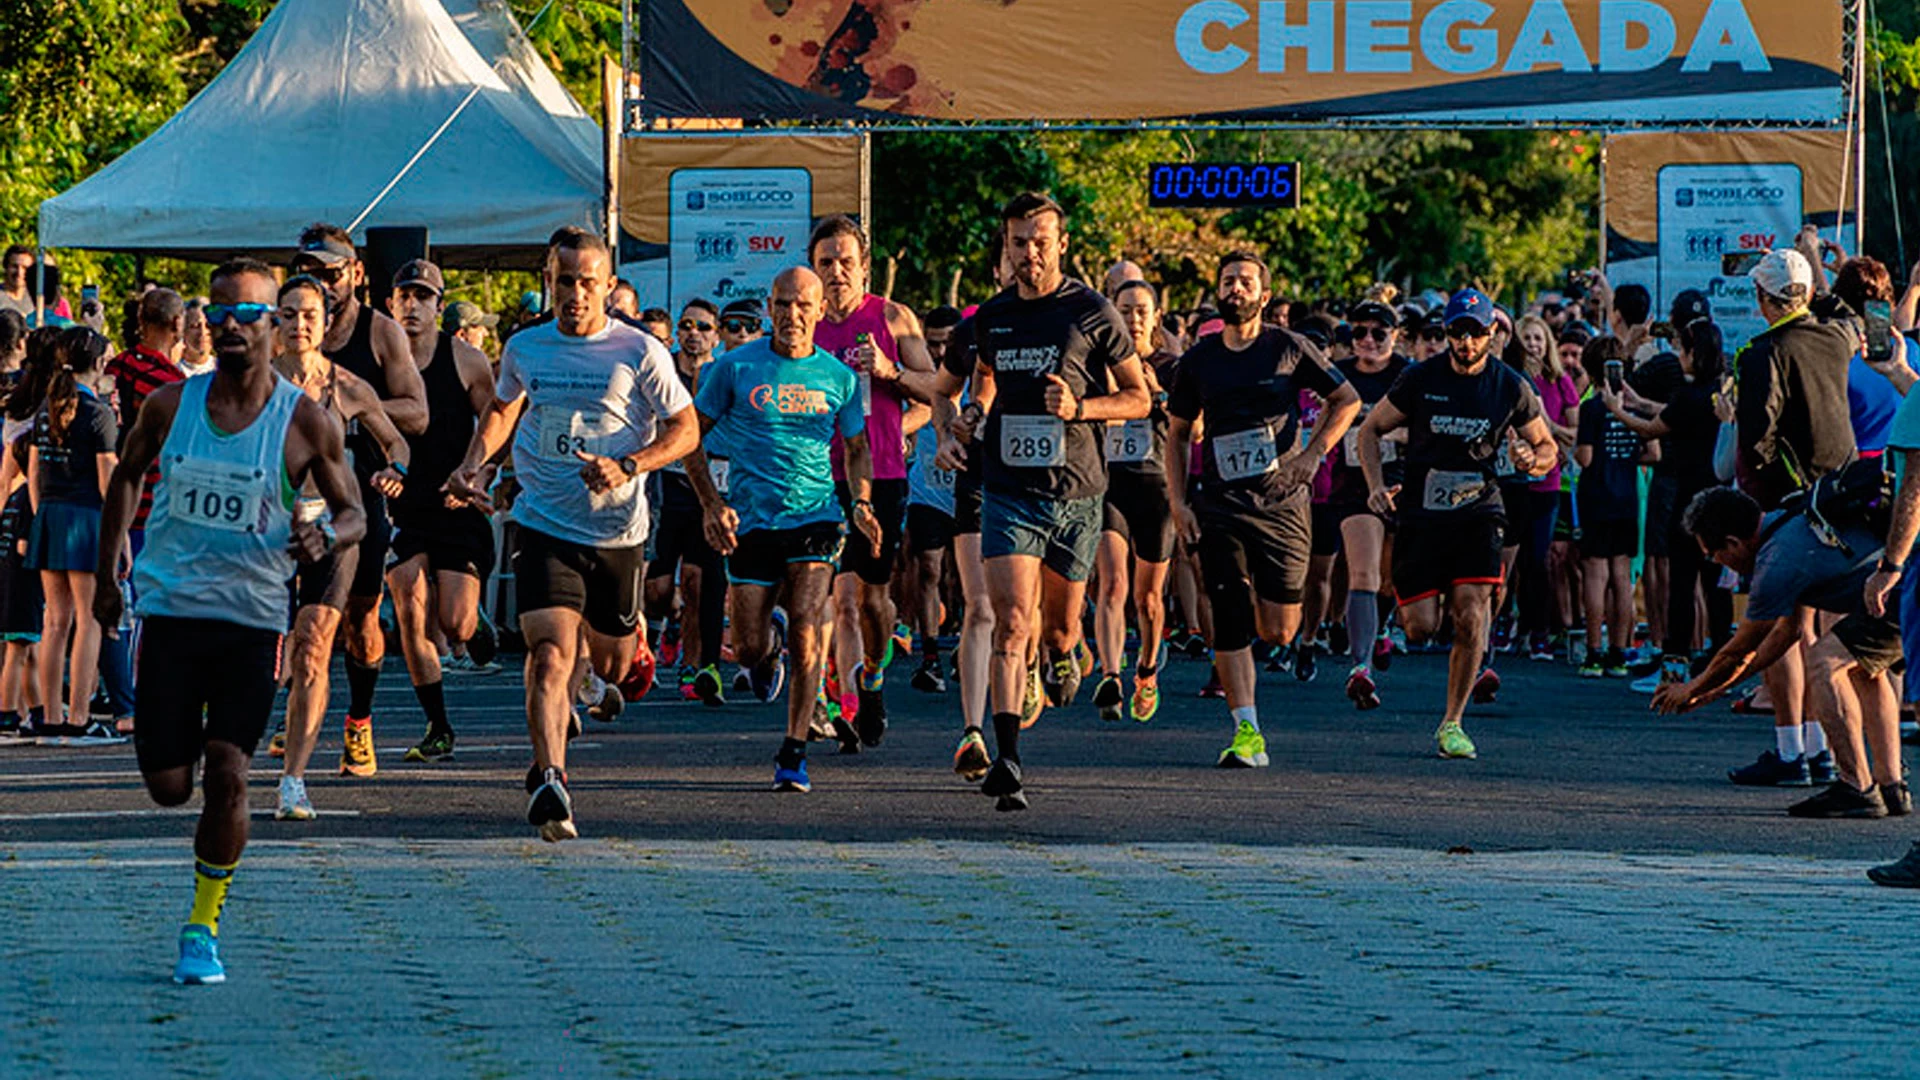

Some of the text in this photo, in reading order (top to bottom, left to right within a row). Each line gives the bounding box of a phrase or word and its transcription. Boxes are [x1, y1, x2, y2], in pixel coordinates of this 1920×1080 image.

[1175, 0, 1773, 73] CHEGADA
[1153, 166, 1291, 198] 00:00:06
[708, 190, 794, 202] SOBLOCO
[748, 236, 784, 250] SIV
[1739, 233, 1776, 249] SIV
[556, 434, 586, 455] 63
[1010, 436, 1052, 458] 289
[1112, 438, 1137, 456] 76
[1227, 447, 1268, 472] 174
[184, 488, 243, 522] 109
